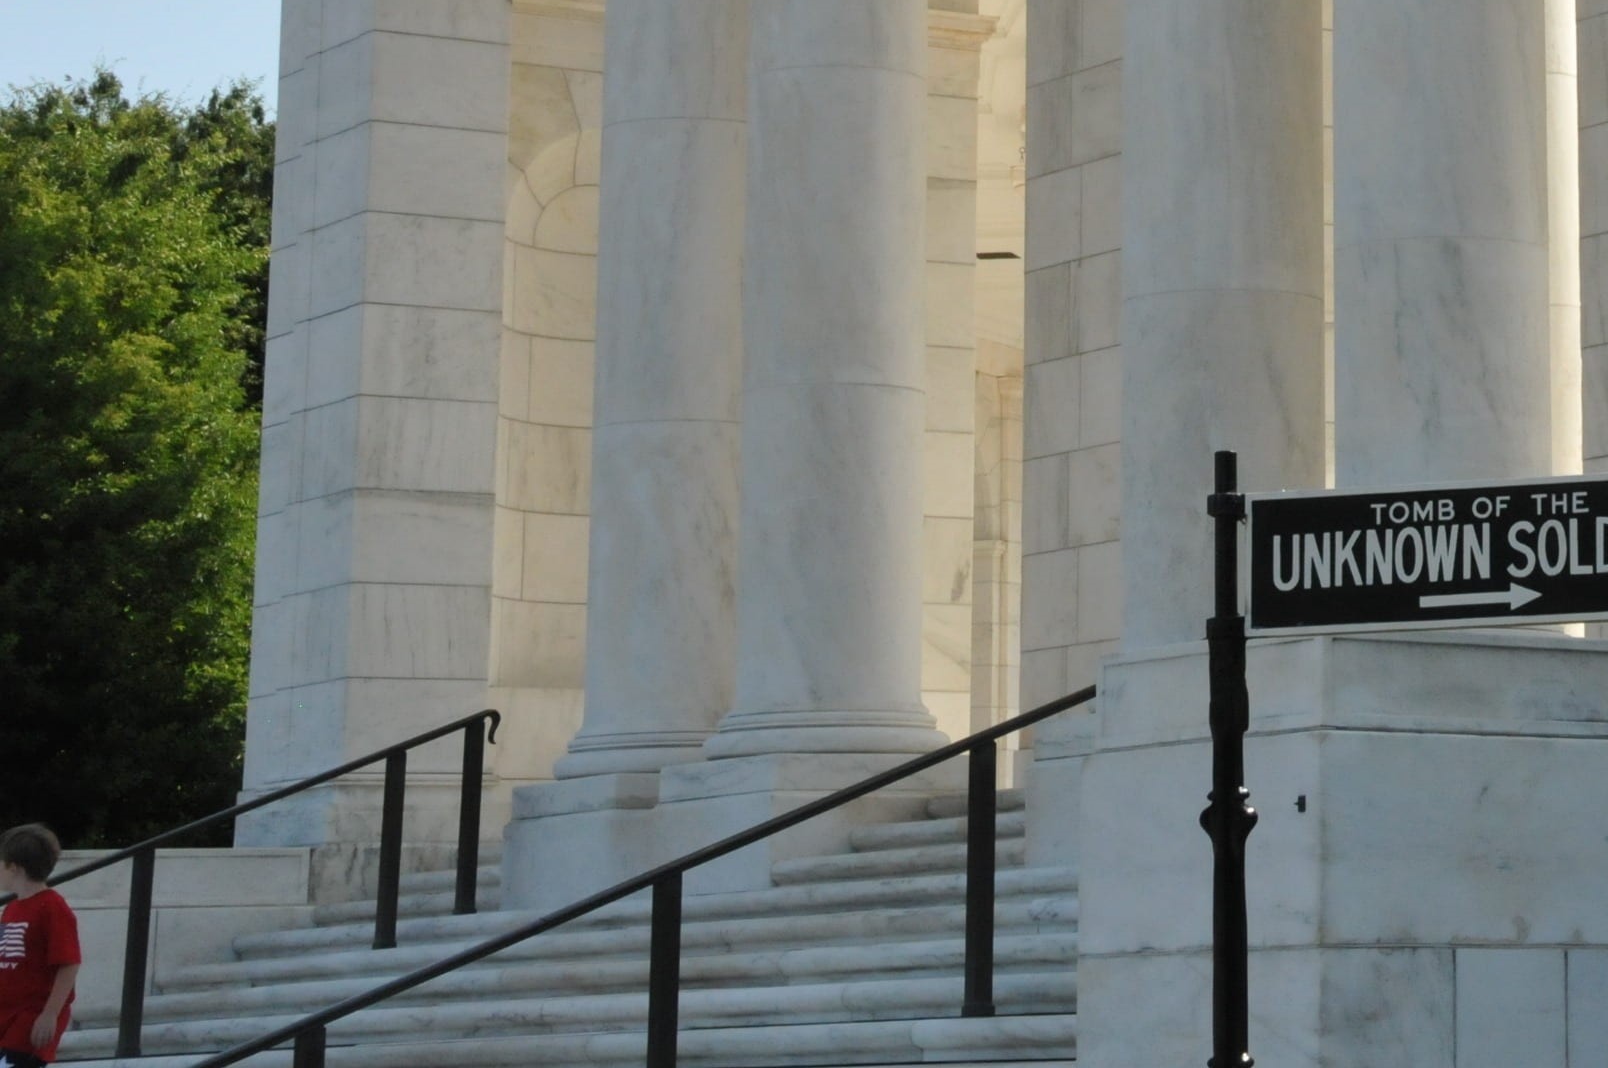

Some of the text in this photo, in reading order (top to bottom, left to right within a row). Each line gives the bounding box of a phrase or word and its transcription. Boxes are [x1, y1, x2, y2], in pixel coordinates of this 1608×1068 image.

[1370, 491, 1590, 525] TOMB OF THE
[1272, 522, 1491, 592] UNKNOWN
